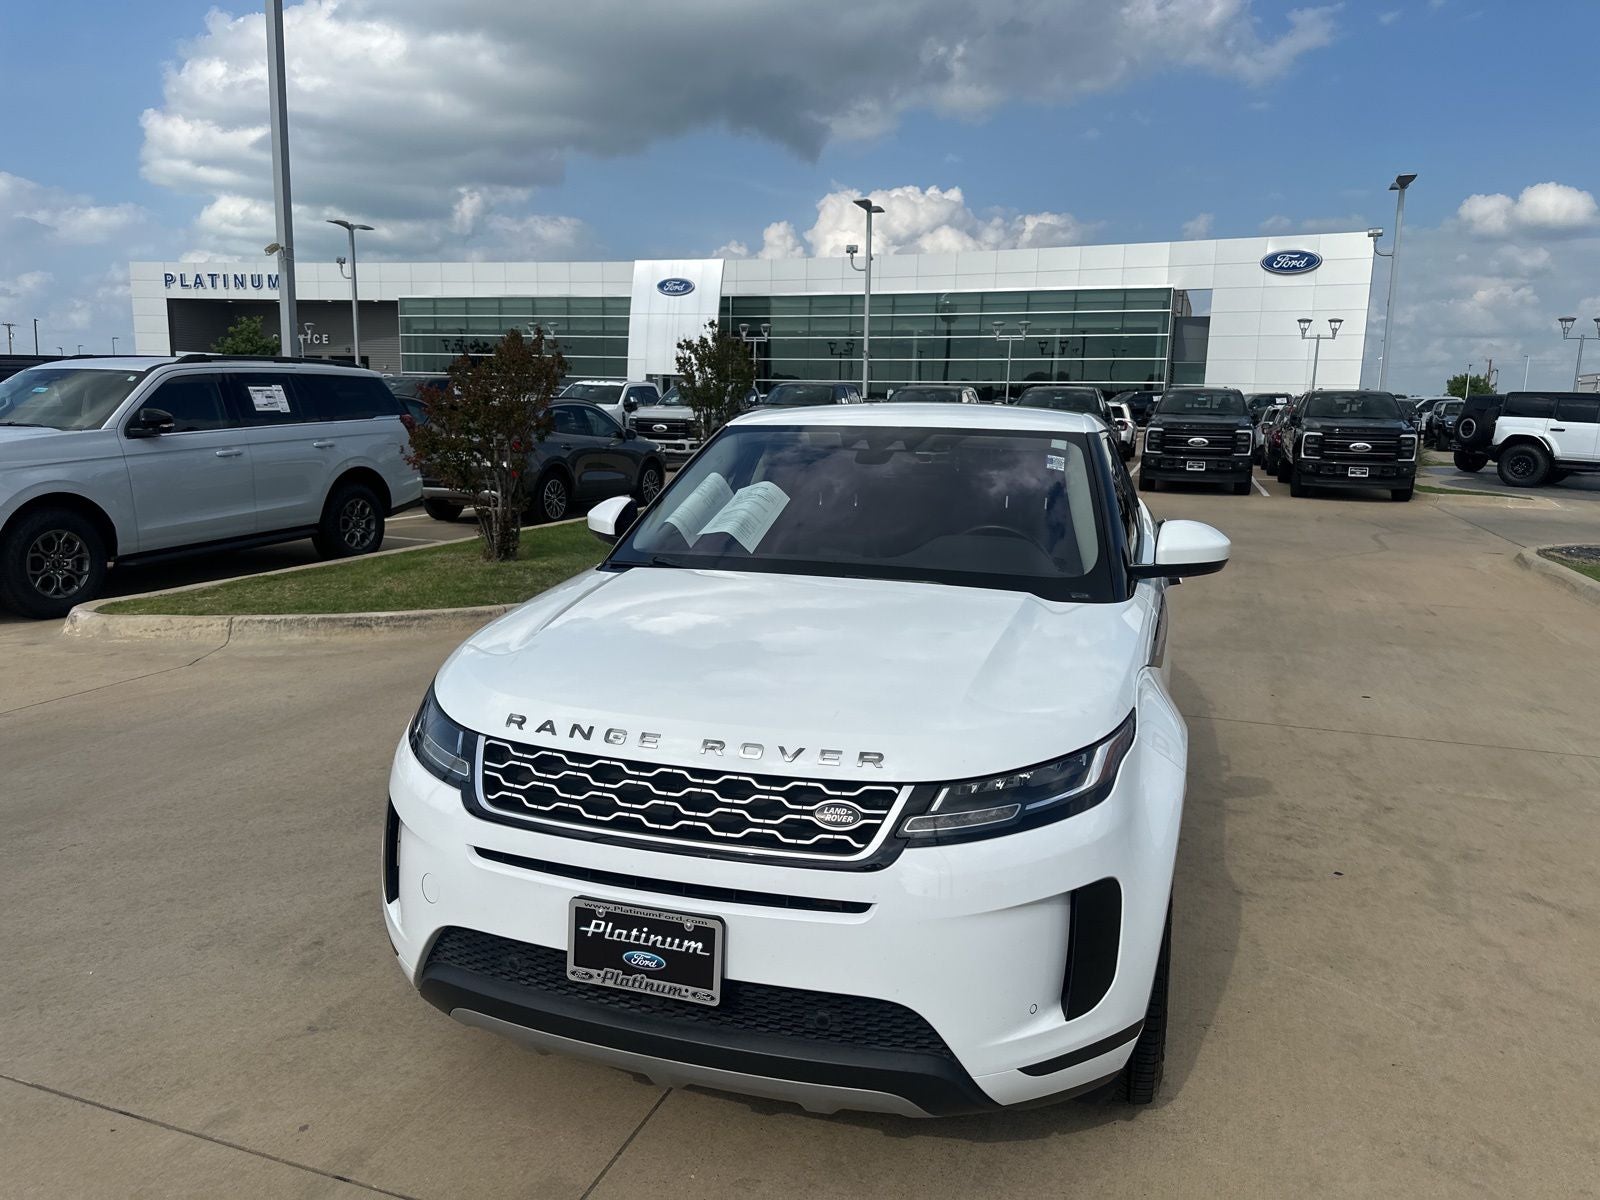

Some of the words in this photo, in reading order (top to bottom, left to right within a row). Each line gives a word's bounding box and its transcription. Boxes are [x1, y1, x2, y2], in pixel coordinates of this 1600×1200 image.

[1272, 253, 1309, 268] Ford
[164, 273, 280, 289] PLATINUM
[505, 712, 662, 750] RANGE
[699, 738, 885, 769] ROVER
[824, 814, 854, 823] ROVER
[583, 902, 708, 926] www.PlatinumFord.com
[579, 919, 711, 956] Platinum
[630, 952, 659, 968] Ford
[600, 969, 689, 998] Platinum
